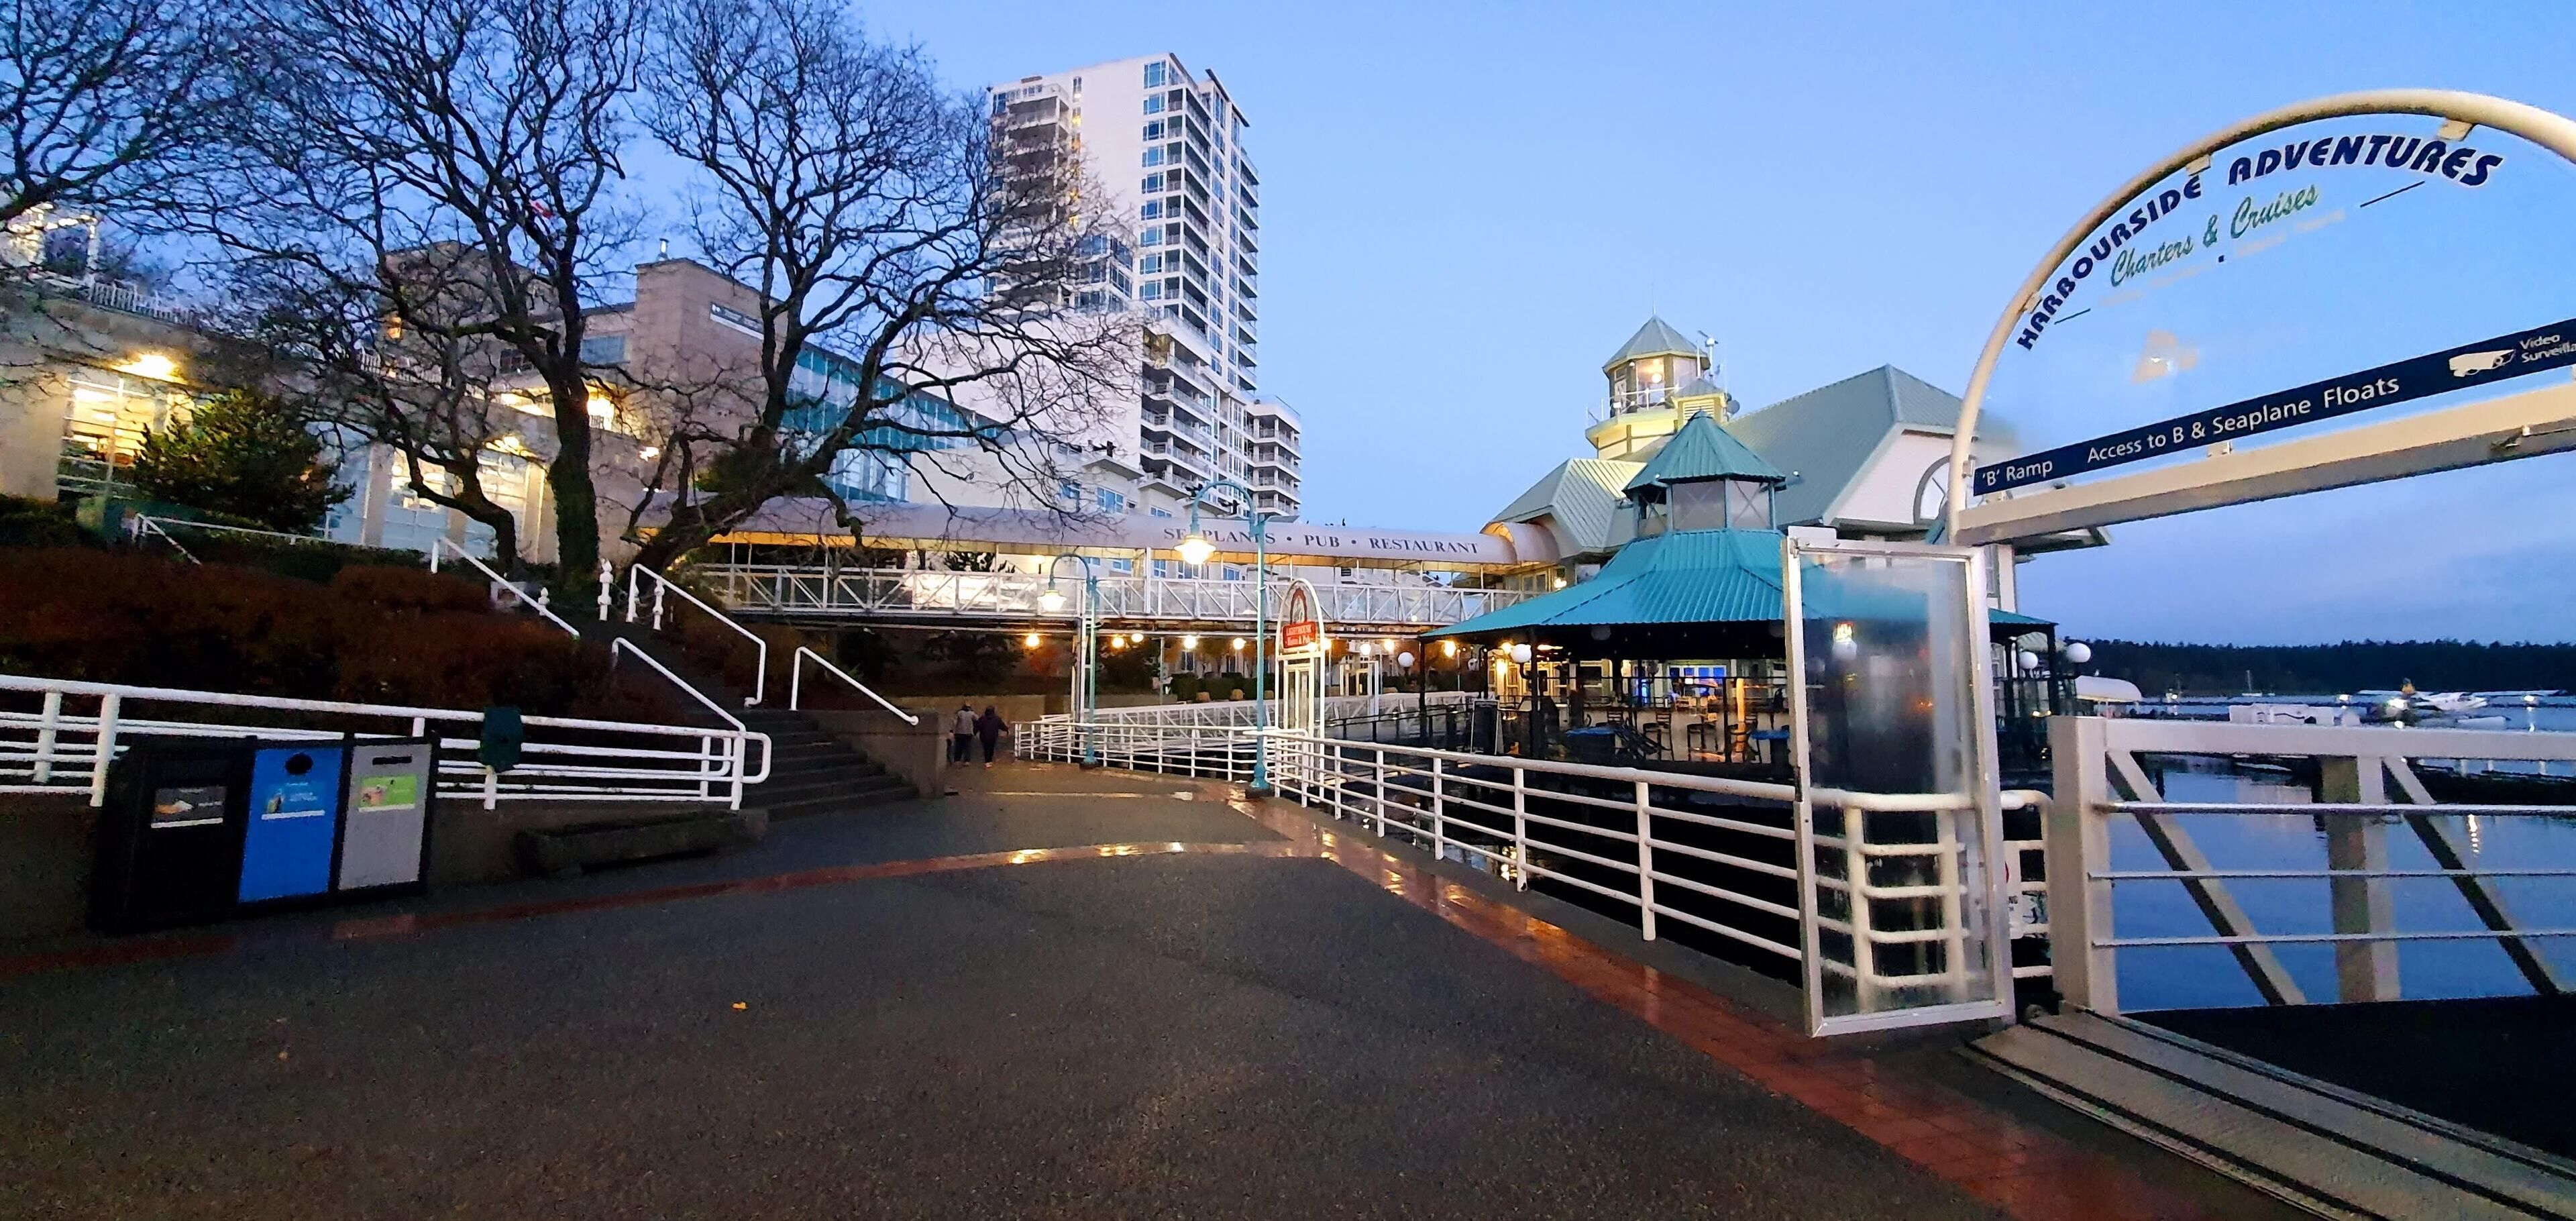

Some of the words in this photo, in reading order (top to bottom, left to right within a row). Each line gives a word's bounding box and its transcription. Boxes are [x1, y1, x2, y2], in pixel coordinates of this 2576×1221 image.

[2017, 175, 2202, 350] HARBOURSIDE
[2228, 135, 2504, 187] ADVENTURES
[2110, 235, 2194, 287] Charters
[2202, 213, 2218, 248] &
[2230, 184, 2319, 239] Cruises
[2520, 334, 2561, 350] Video
[2006, 460, 2053, 482] Ramp
[2087, 438, 2142, 464] Access
[2147, 433, 2166, 449] to
[2172, 426, 2184, 443] B
[2192, 421, 2206, 439] &
[2212, 399, 2312, 433] Seaplane
[2323, 376, 2400, 409] Floats
[1304, 534, 1341, 548] PUB
[1369, 537, 1479, 554] RESTAURANT
